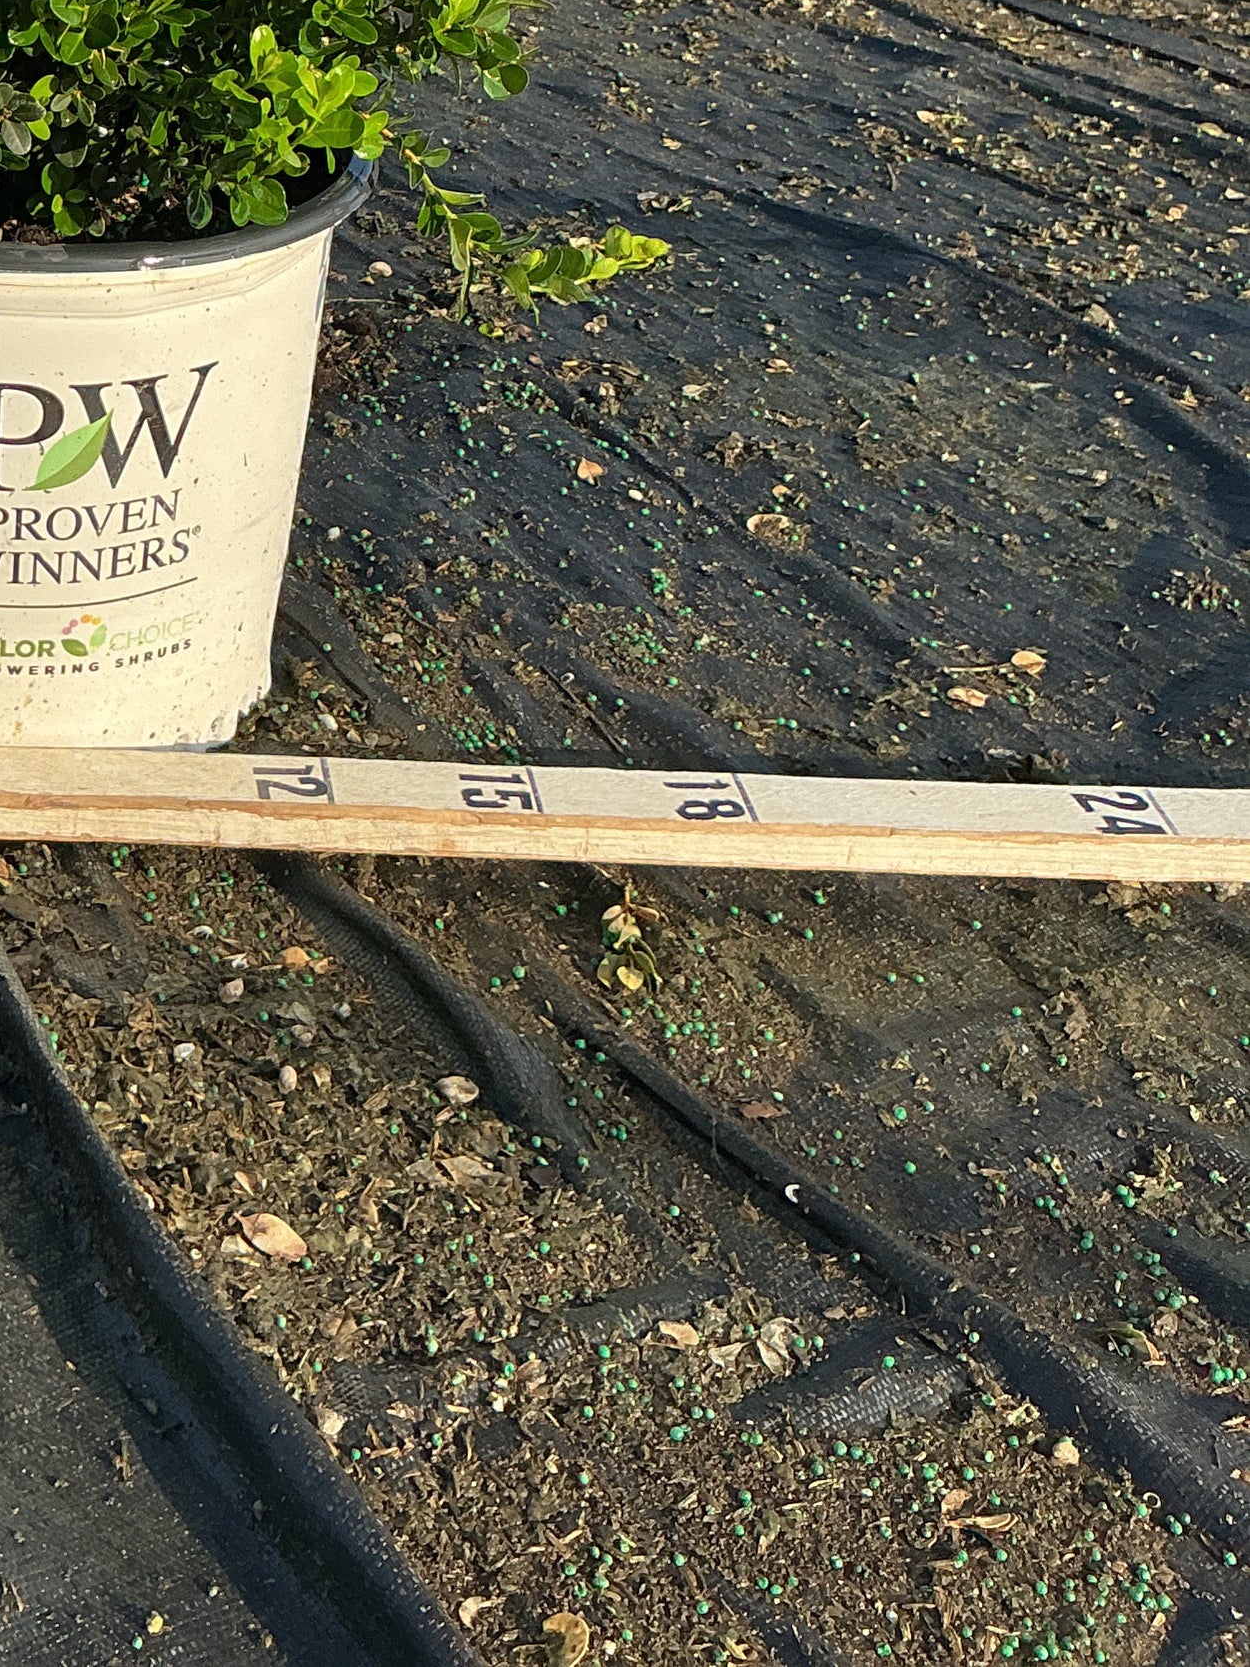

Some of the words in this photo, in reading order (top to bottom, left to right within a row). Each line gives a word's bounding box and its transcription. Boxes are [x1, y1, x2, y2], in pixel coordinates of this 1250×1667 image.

[109, 612, 196, 652] CHOICE
[114, 638, 193, 669] SHRUBS
[252, 764, 329, 800] 12
[458, 773, 534, 811] 15
[662, 778, 746, 821] 18
[1070, 791, 1169, 835] 24
